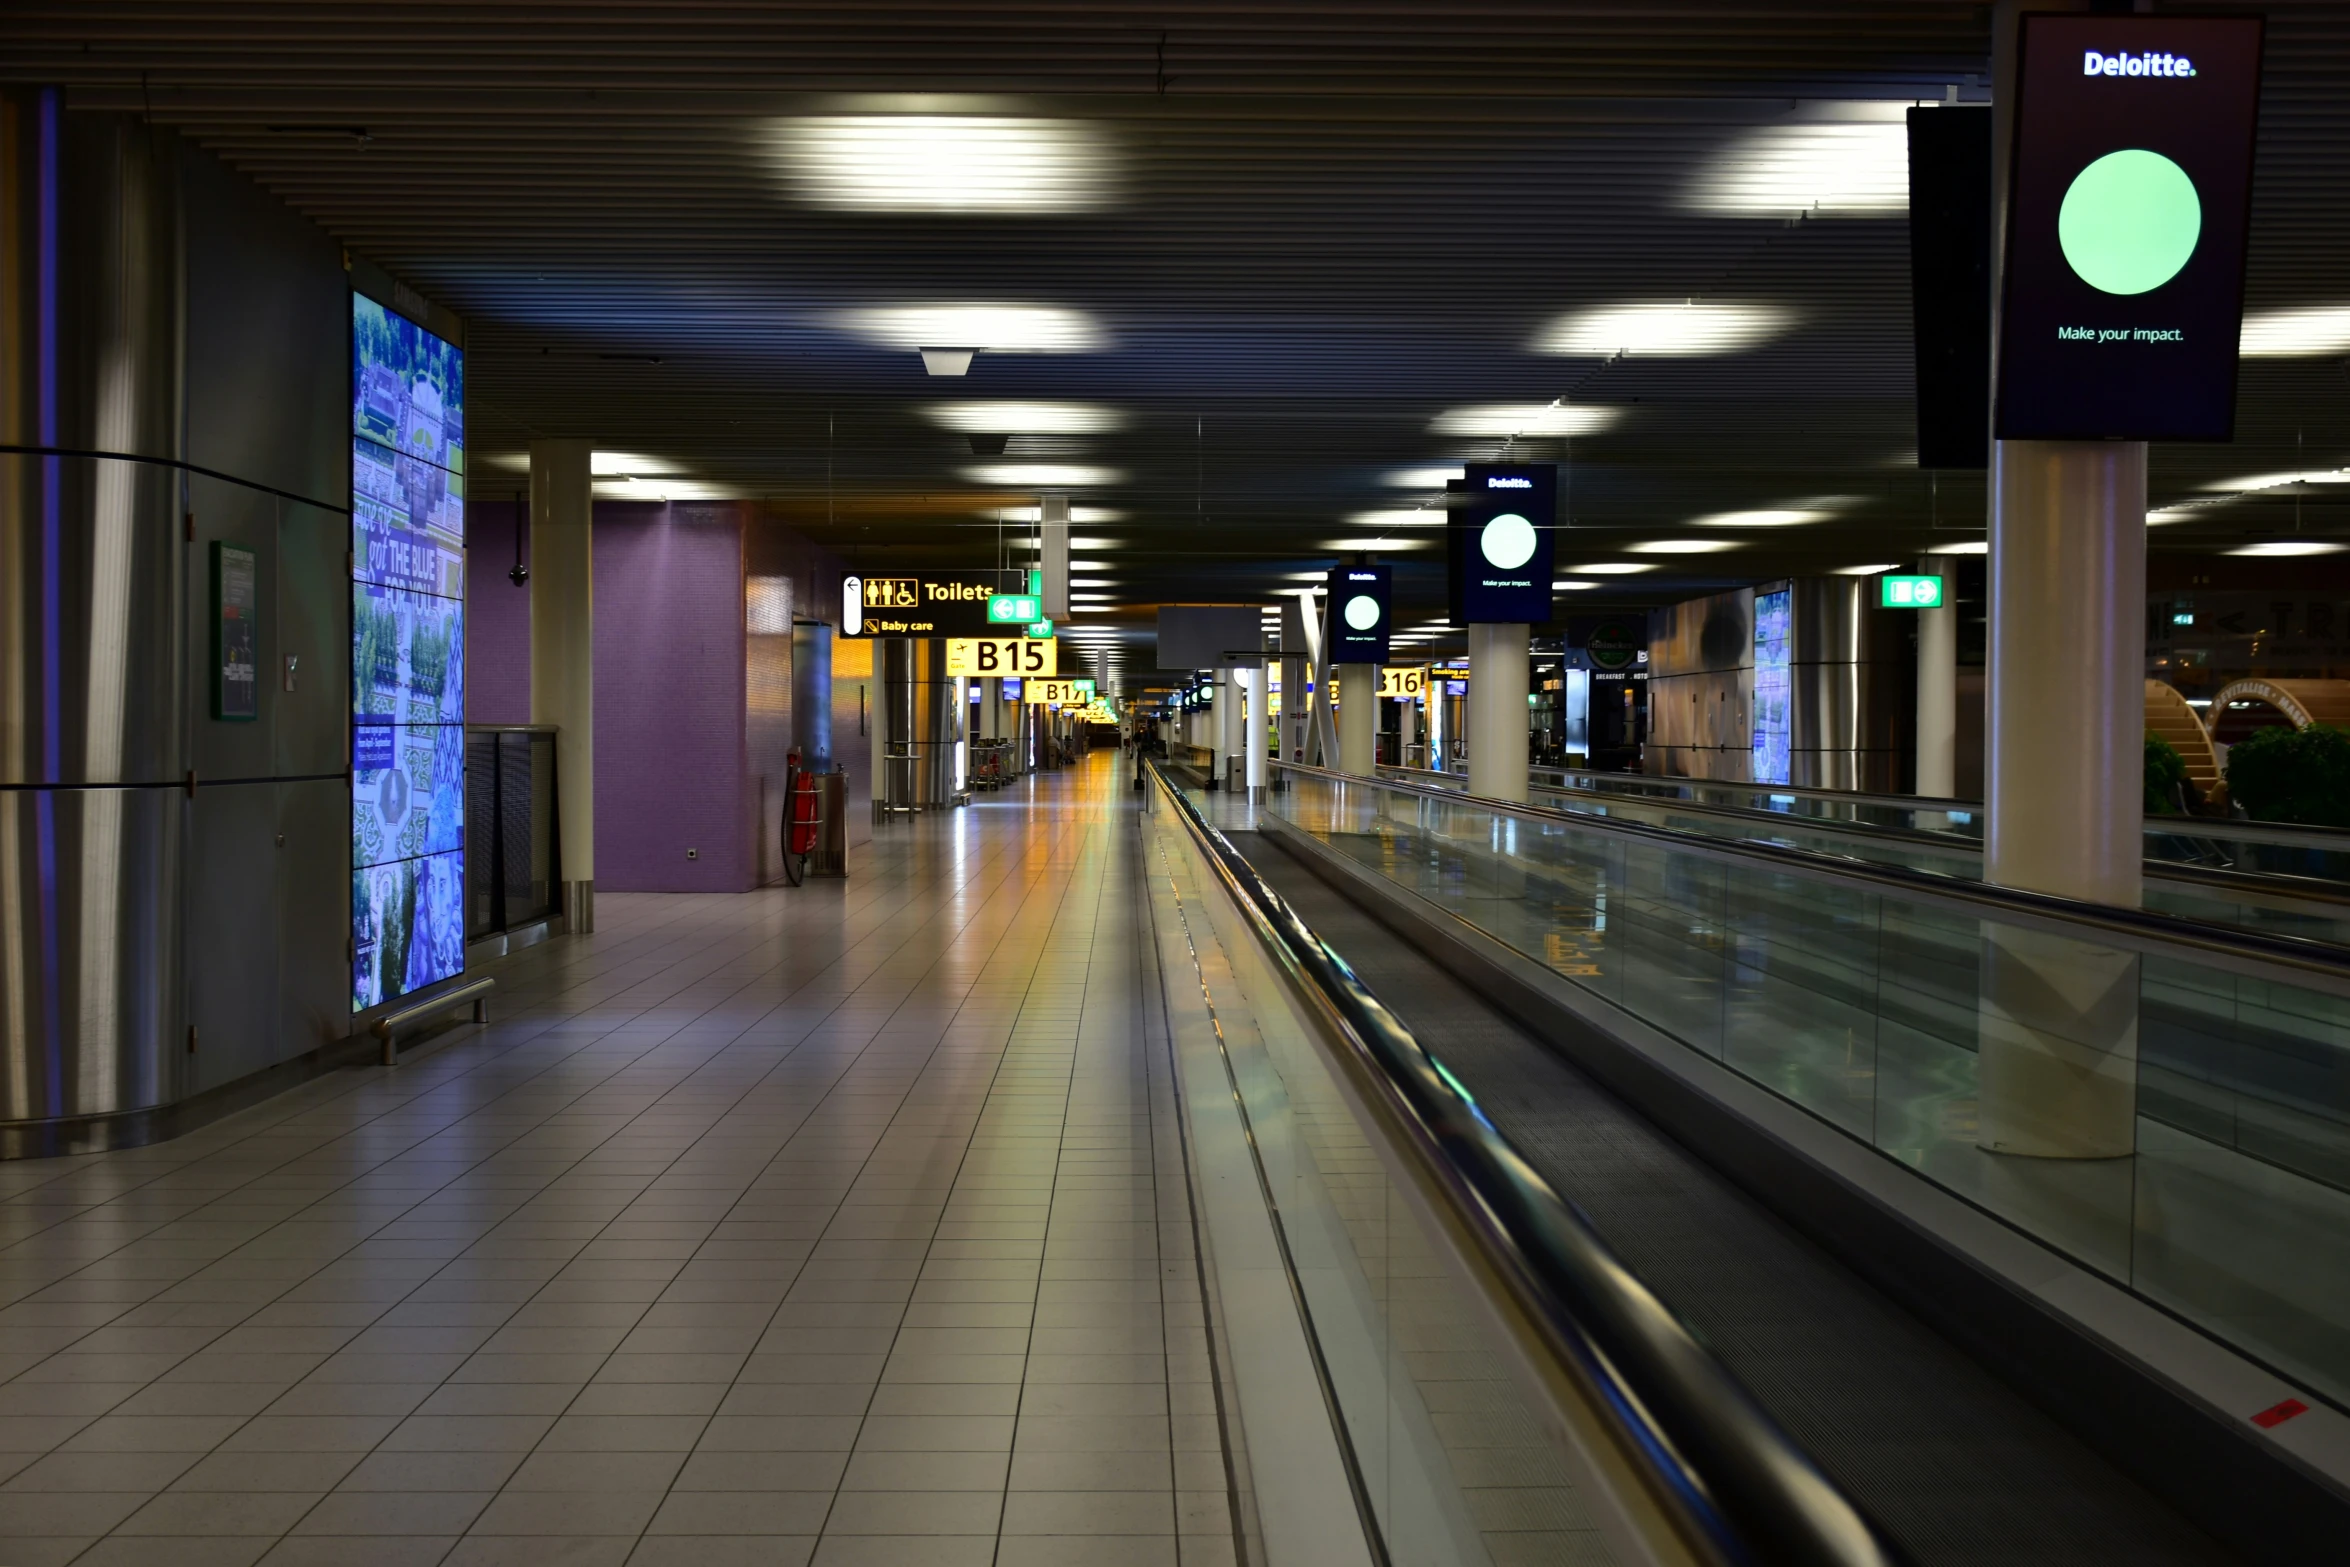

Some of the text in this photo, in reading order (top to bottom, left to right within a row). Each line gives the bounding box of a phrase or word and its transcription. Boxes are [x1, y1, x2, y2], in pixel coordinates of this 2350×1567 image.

[2058, 326, 2184, 344] Make your impact.
[367, 536, 436, 589] got THE BLUE
[384, 575, 431, 617] FOR YOU
[925, 582, 994, 601] Toilets
[881, 621, 934, 633] Baby care
[2270, 602, 2350, 640] TR
[950, 662, 965, 670] Gate
[978, 641, 1044, 672] B15
[2213, 681, 2271, 711] REVITALISE
